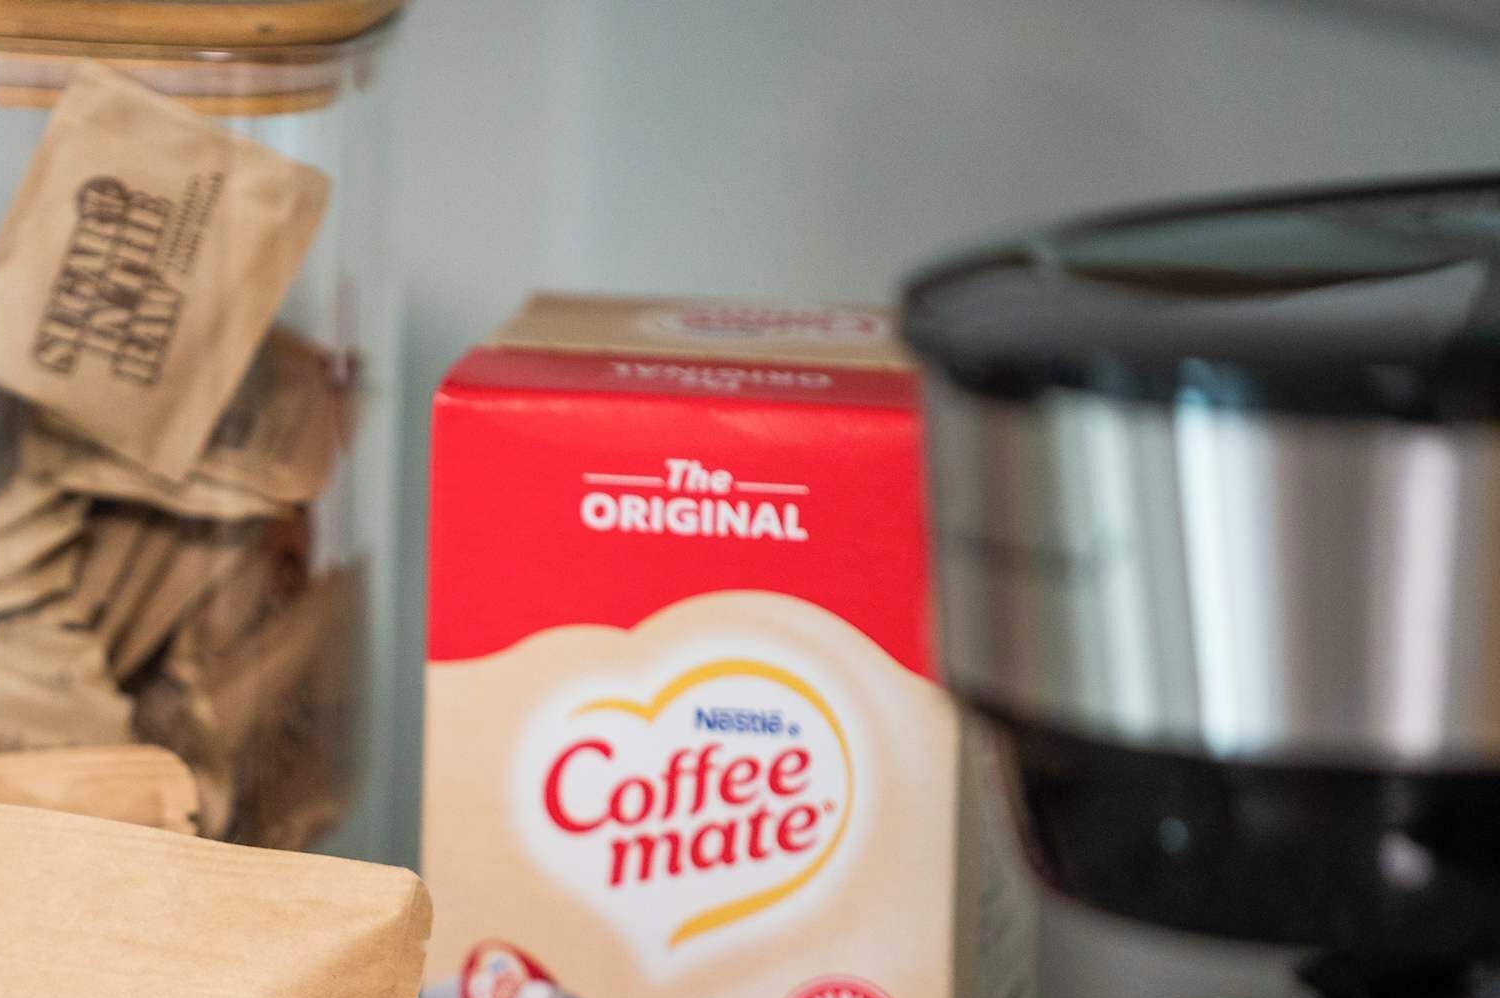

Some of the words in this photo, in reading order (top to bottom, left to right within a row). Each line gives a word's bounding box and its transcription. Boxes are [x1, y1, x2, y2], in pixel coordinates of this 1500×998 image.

[665, 457, 733, 495] The
[580, 492, 809, 541] ORIGINAL
[542, 737, 813, 837] Coffee
[606, 804, 821, 890] mate
